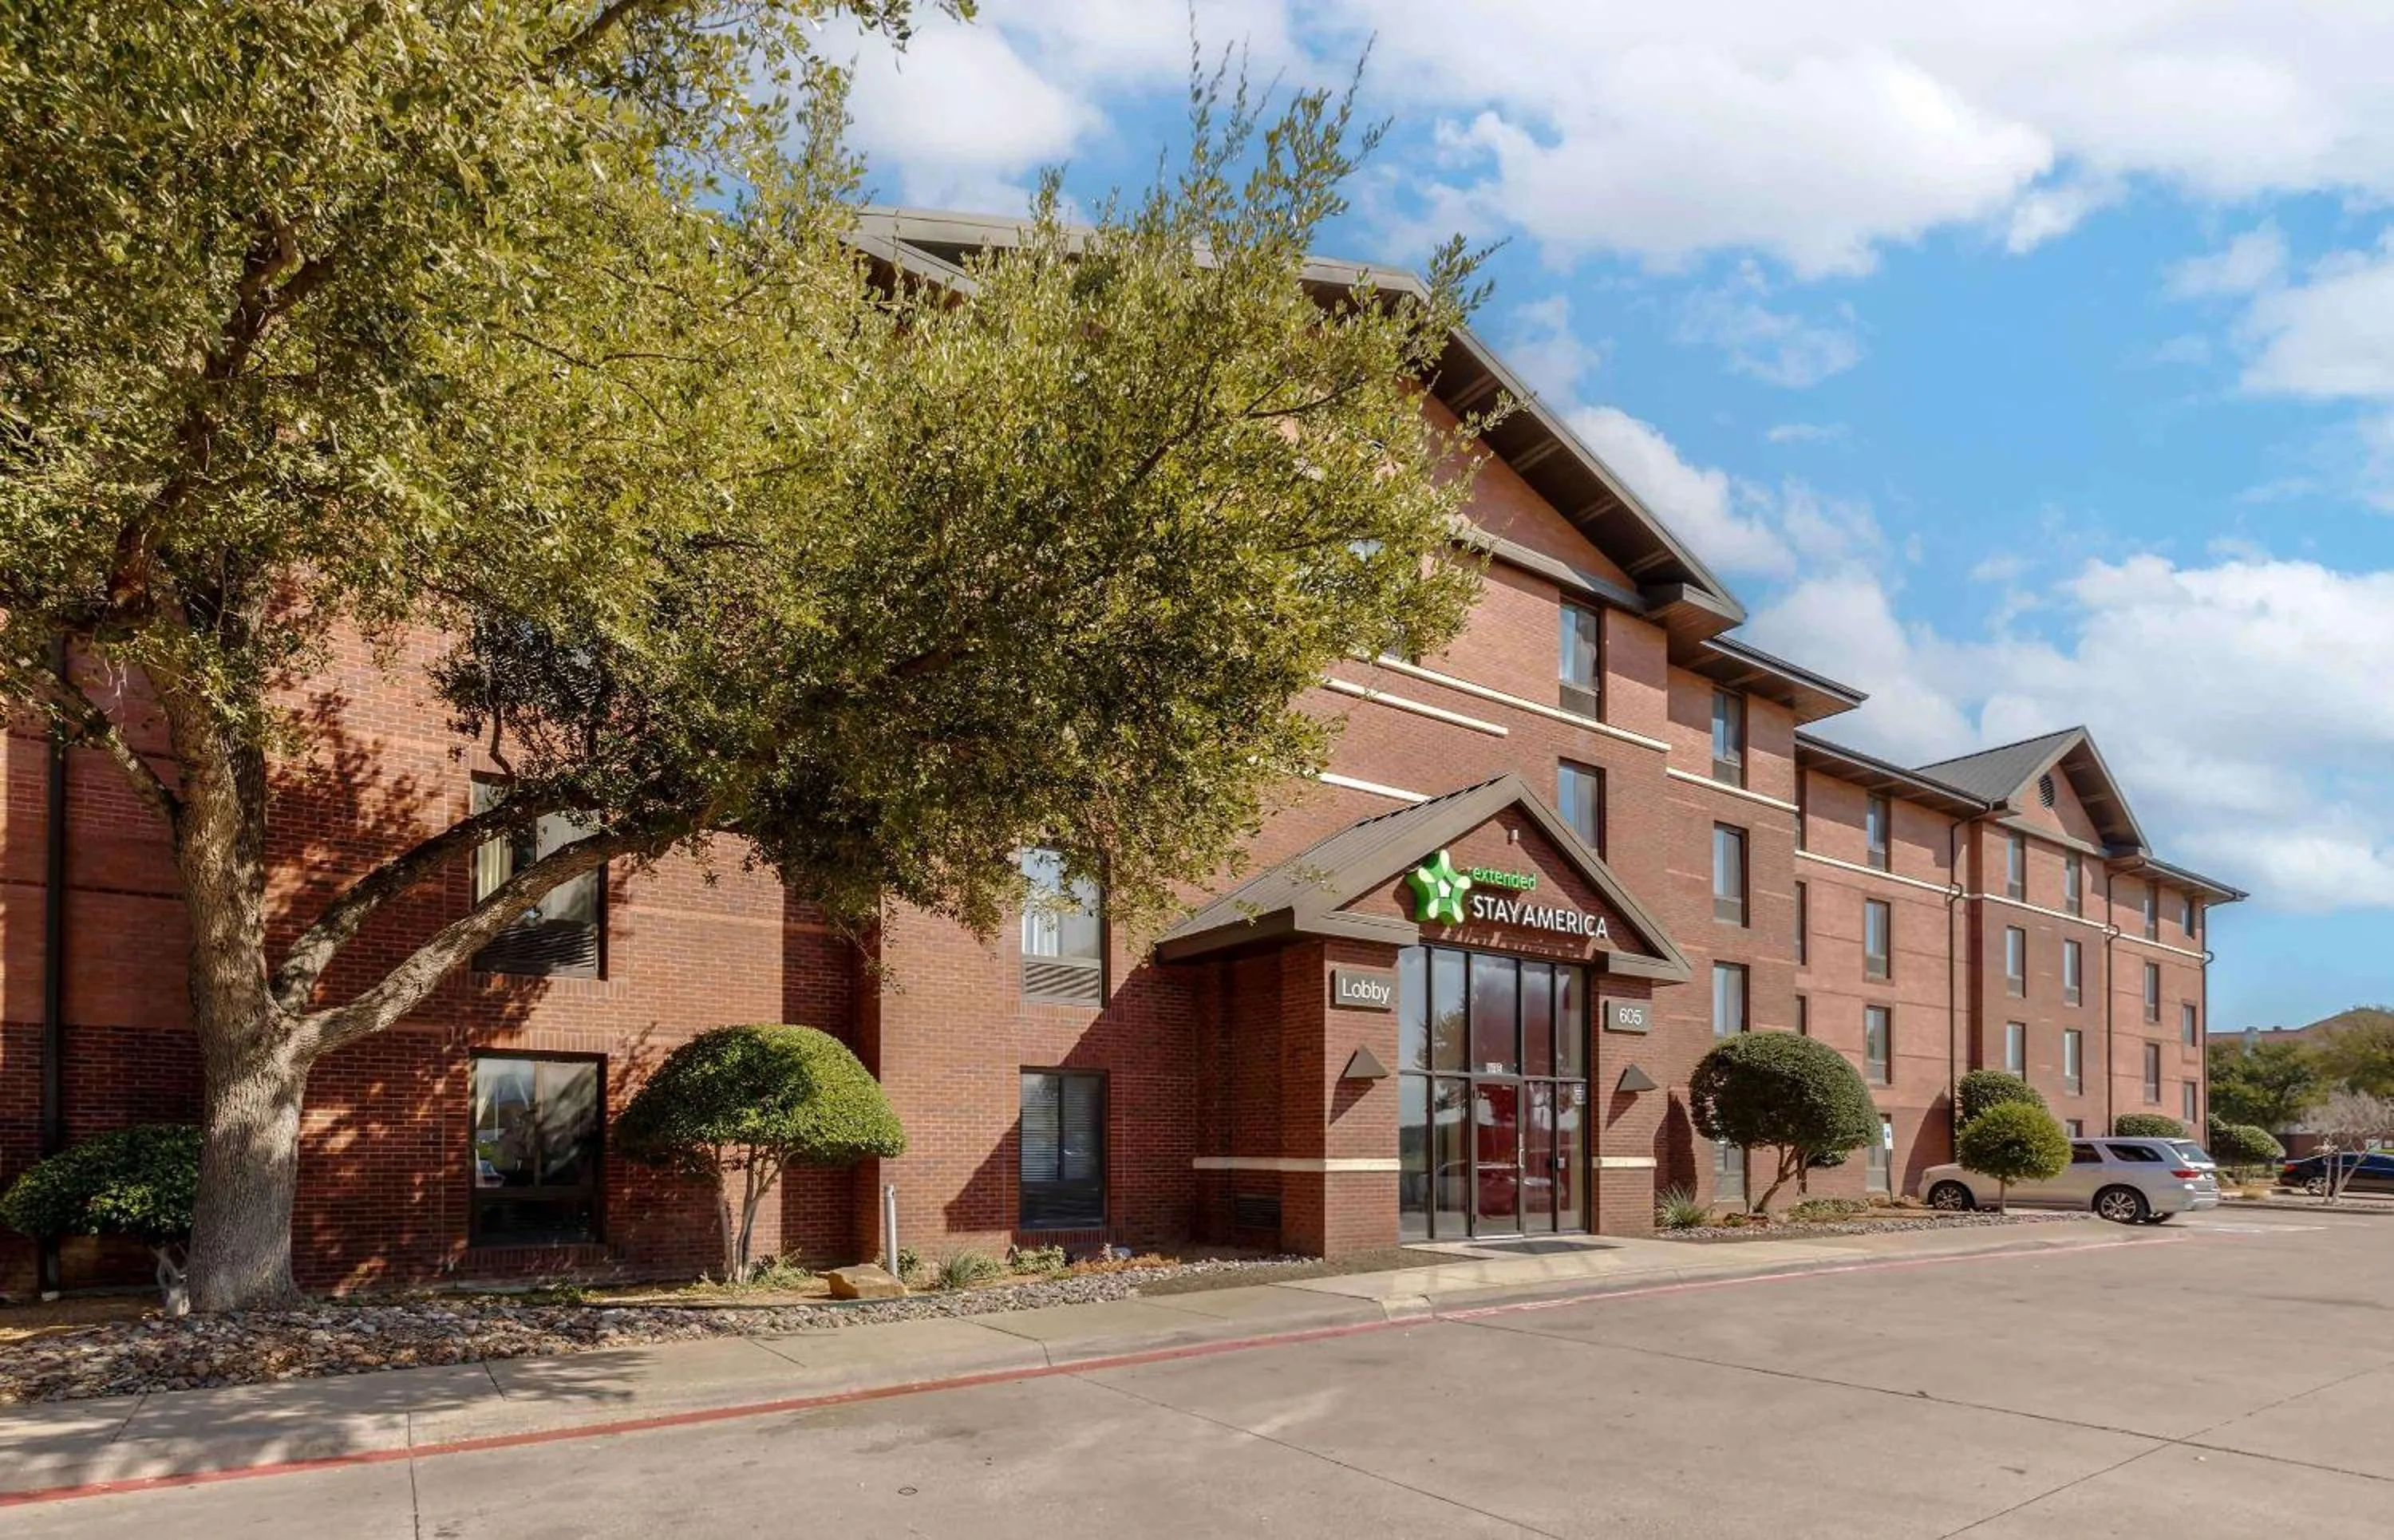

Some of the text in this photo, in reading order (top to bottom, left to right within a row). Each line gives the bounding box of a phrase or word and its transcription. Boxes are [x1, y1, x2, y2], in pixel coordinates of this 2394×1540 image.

[1472, 867, 1536, 890] extended
[1472, 894, 1608, 938] STAY AMERICA
[1341, 977, 1390, 1005] Lobby
[1619, 1008, 1641, 1025] 605
